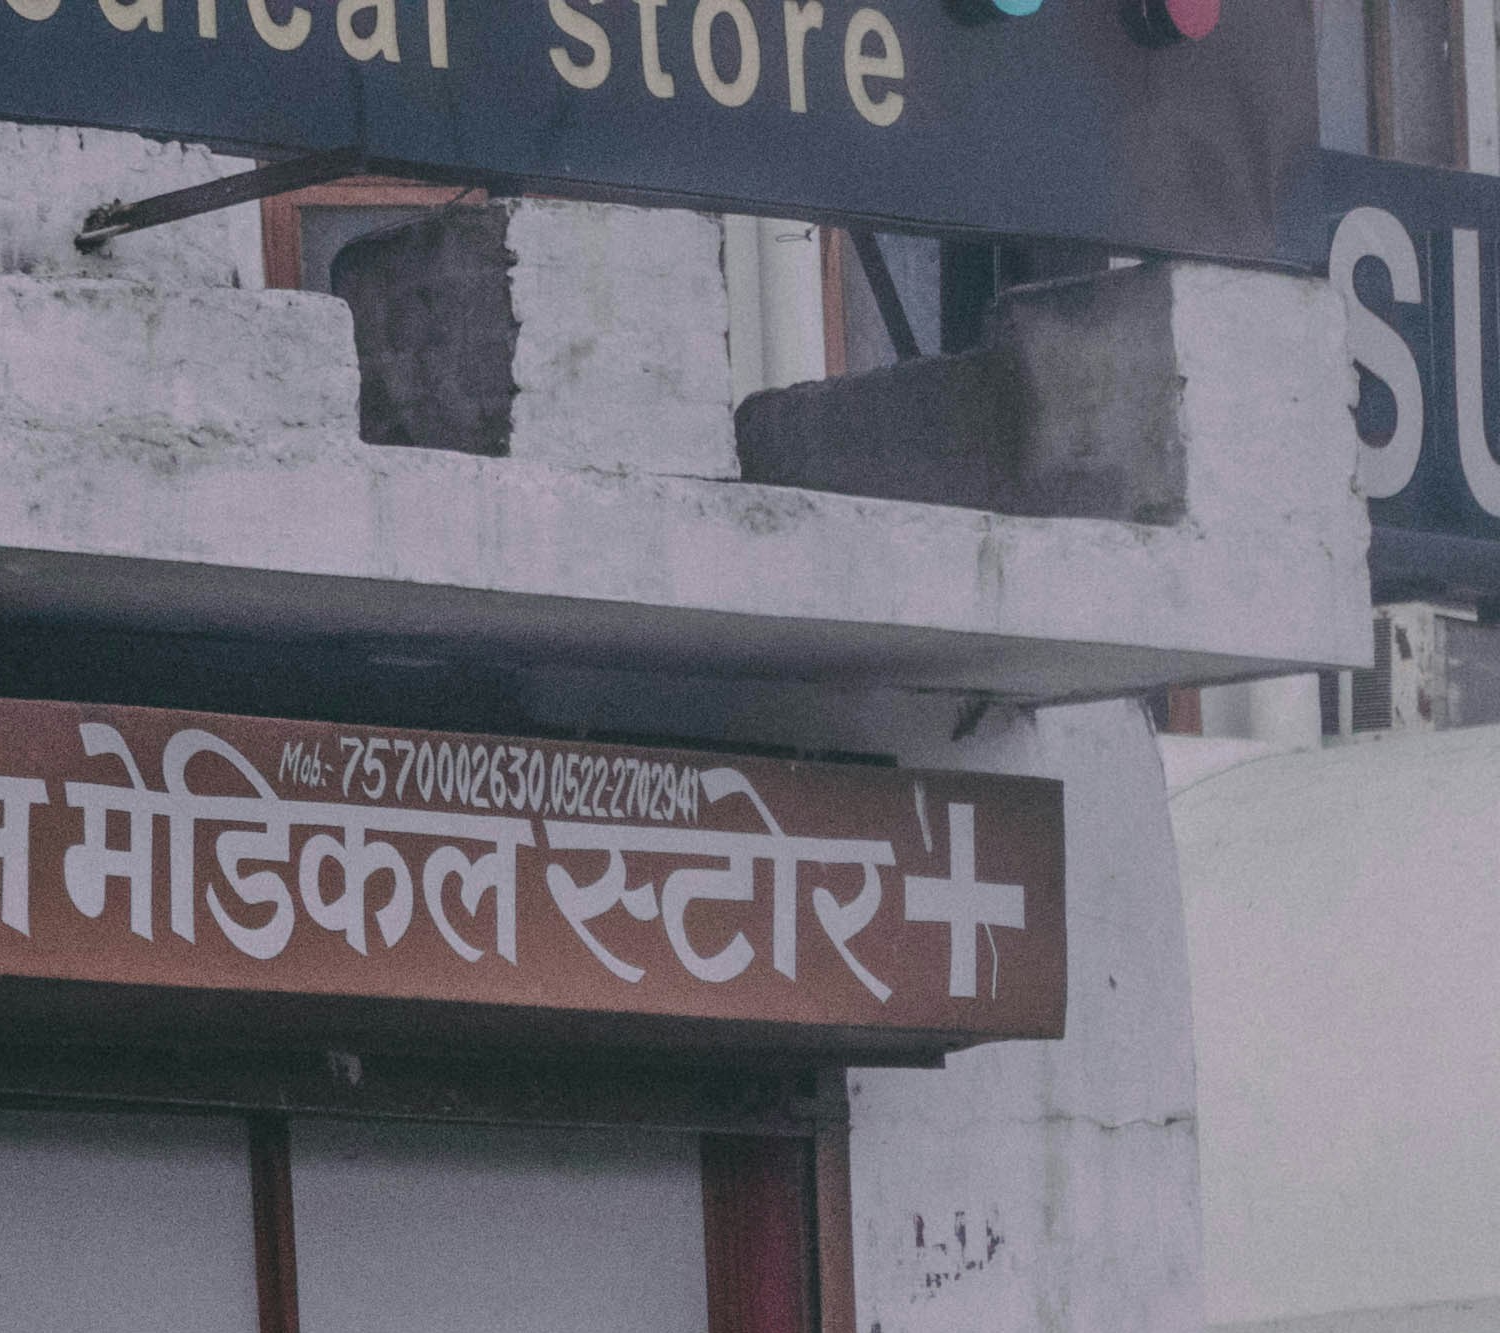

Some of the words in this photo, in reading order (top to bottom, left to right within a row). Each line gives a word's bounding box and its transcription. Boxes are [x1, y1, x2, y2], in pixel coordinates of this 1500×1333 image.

[547, 0, 905, 127] store
[62, 721, 534, 964] मेडिकल
[543, 769, 896, 1003] स्टोर
